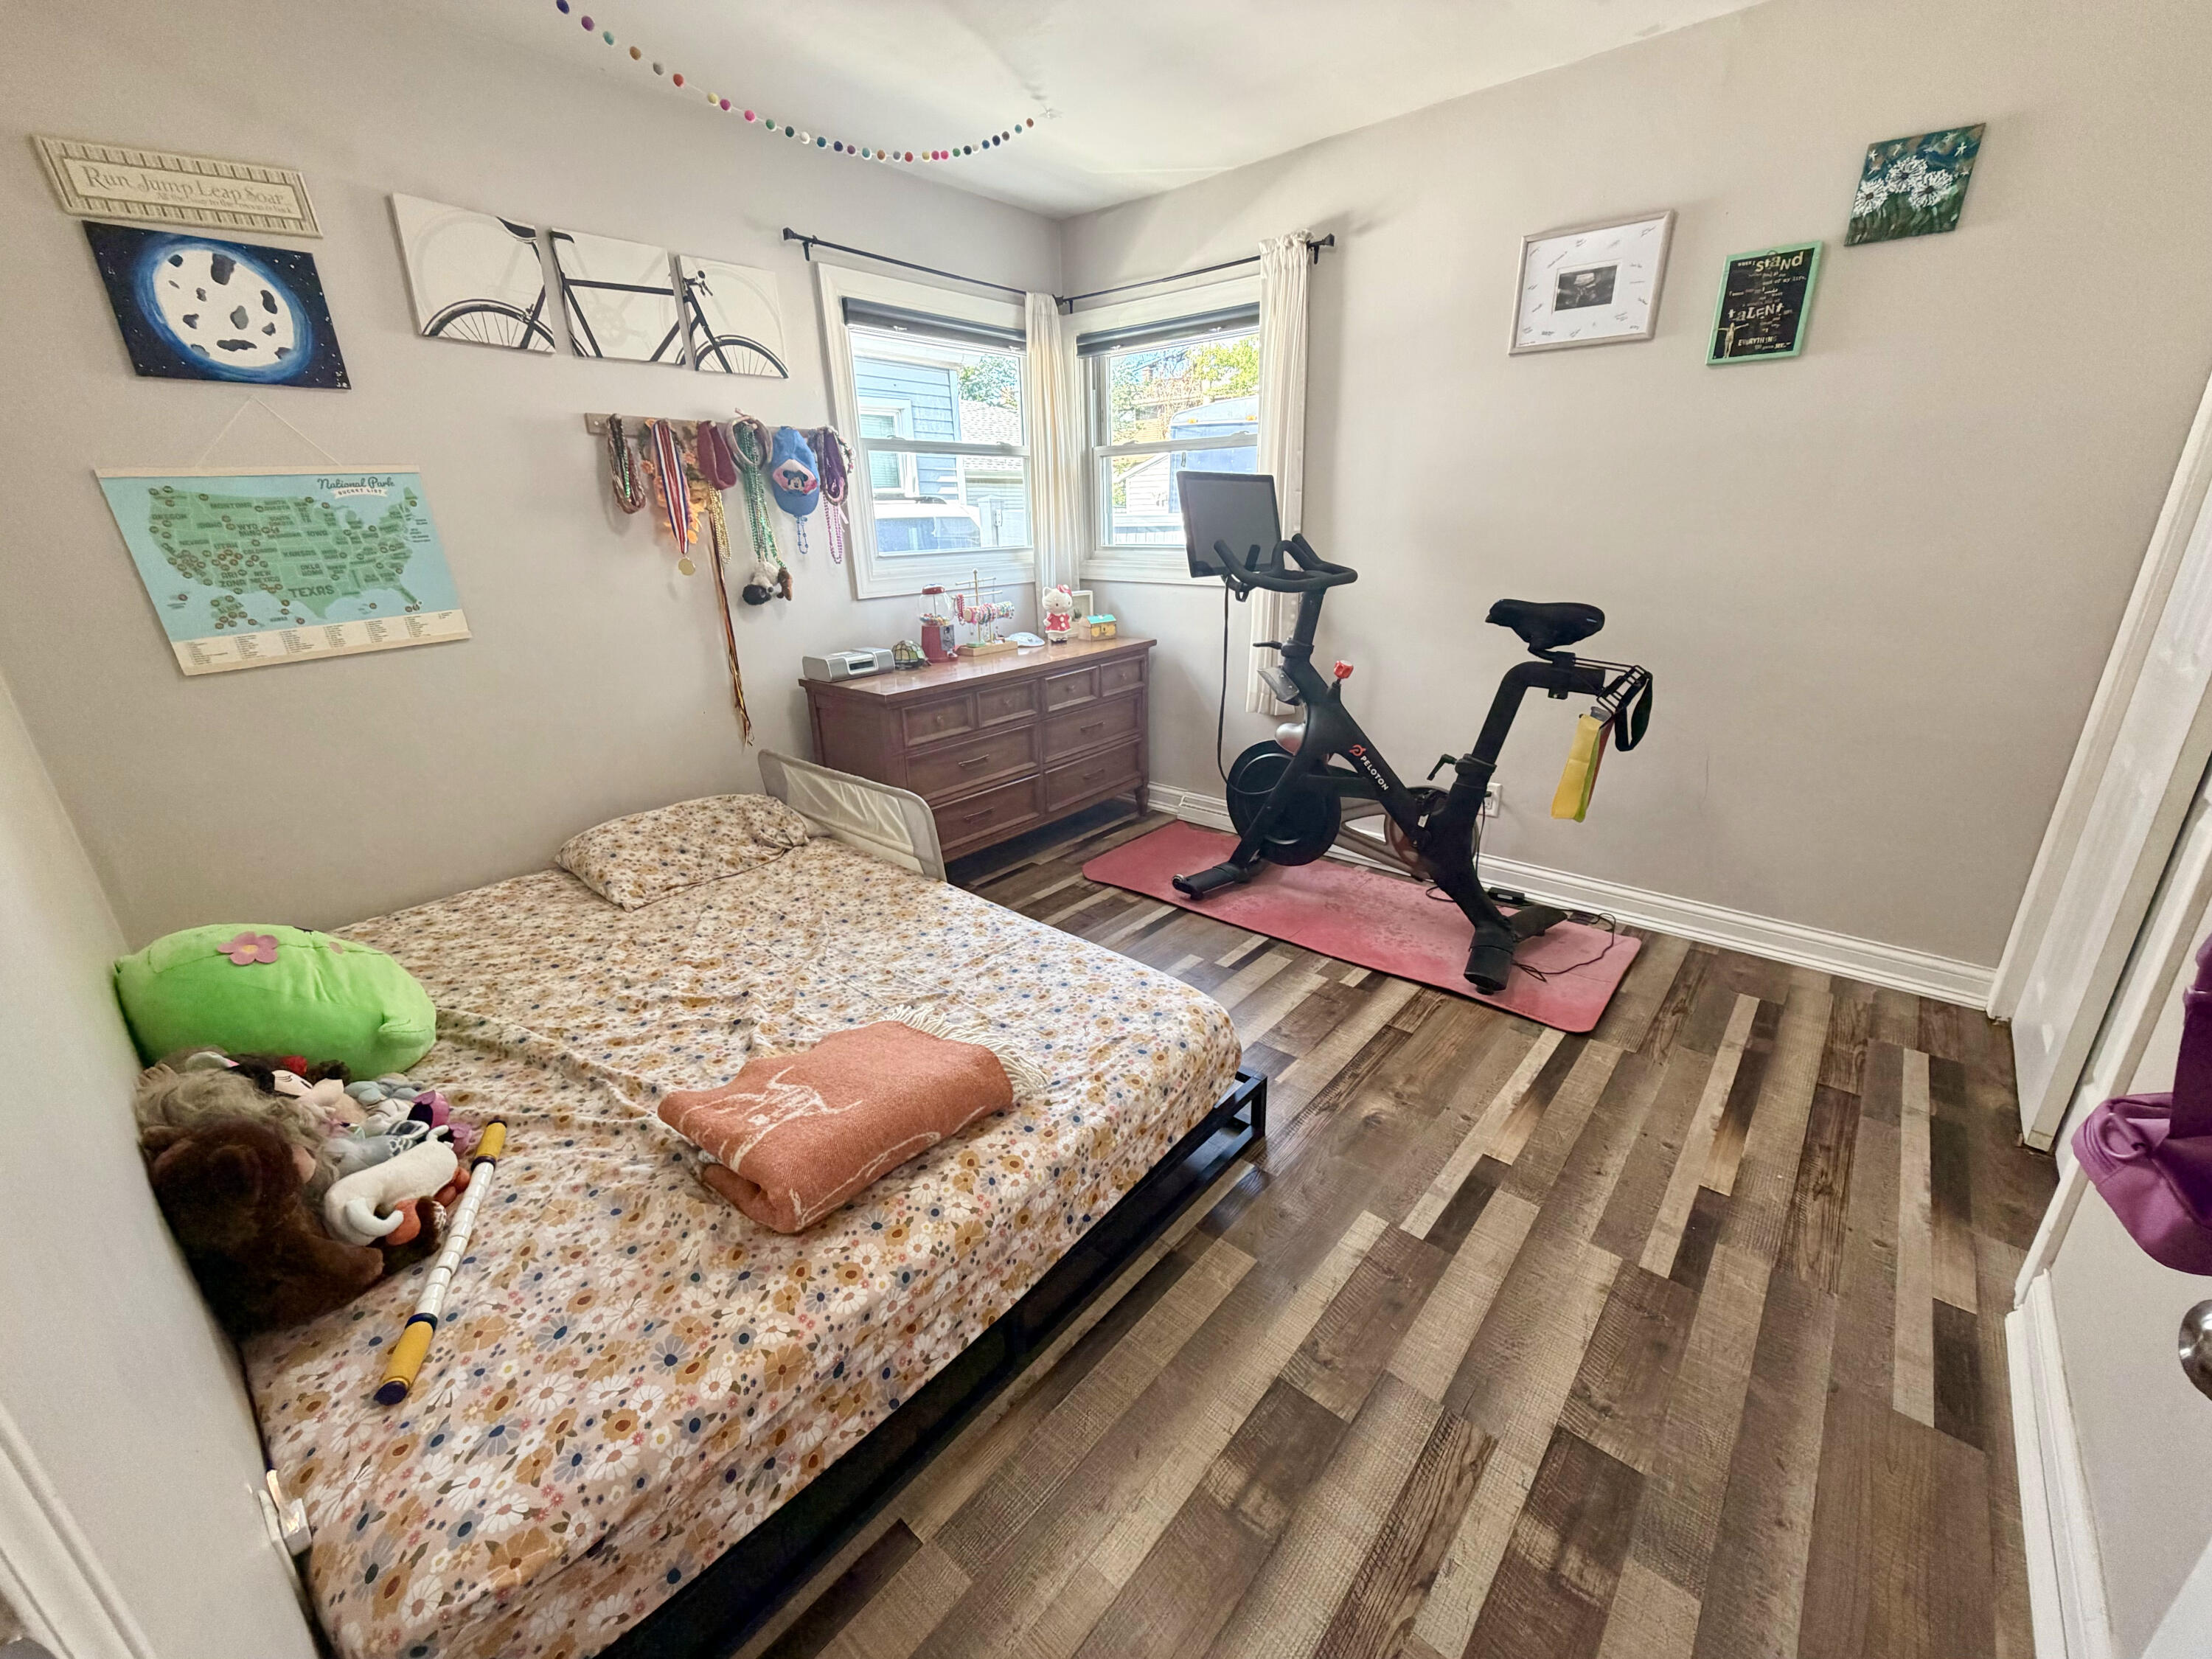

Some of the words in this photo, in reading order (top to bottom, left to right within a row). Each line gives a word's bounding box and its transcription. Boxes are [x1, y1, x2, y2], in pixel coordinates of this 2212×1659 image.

[80, 165, 133, 190] Run
[137, 173, 193, 199] Jump
[196, 180, 242, 205] Leap
[244, 186, 284, 204] Soar
[317, 478, 366, 490] National
[369, 476, 395, 489] Park
[288, 585, 335, 598] TEXAS
[1360, 755, 1389, 790] PELOTON
